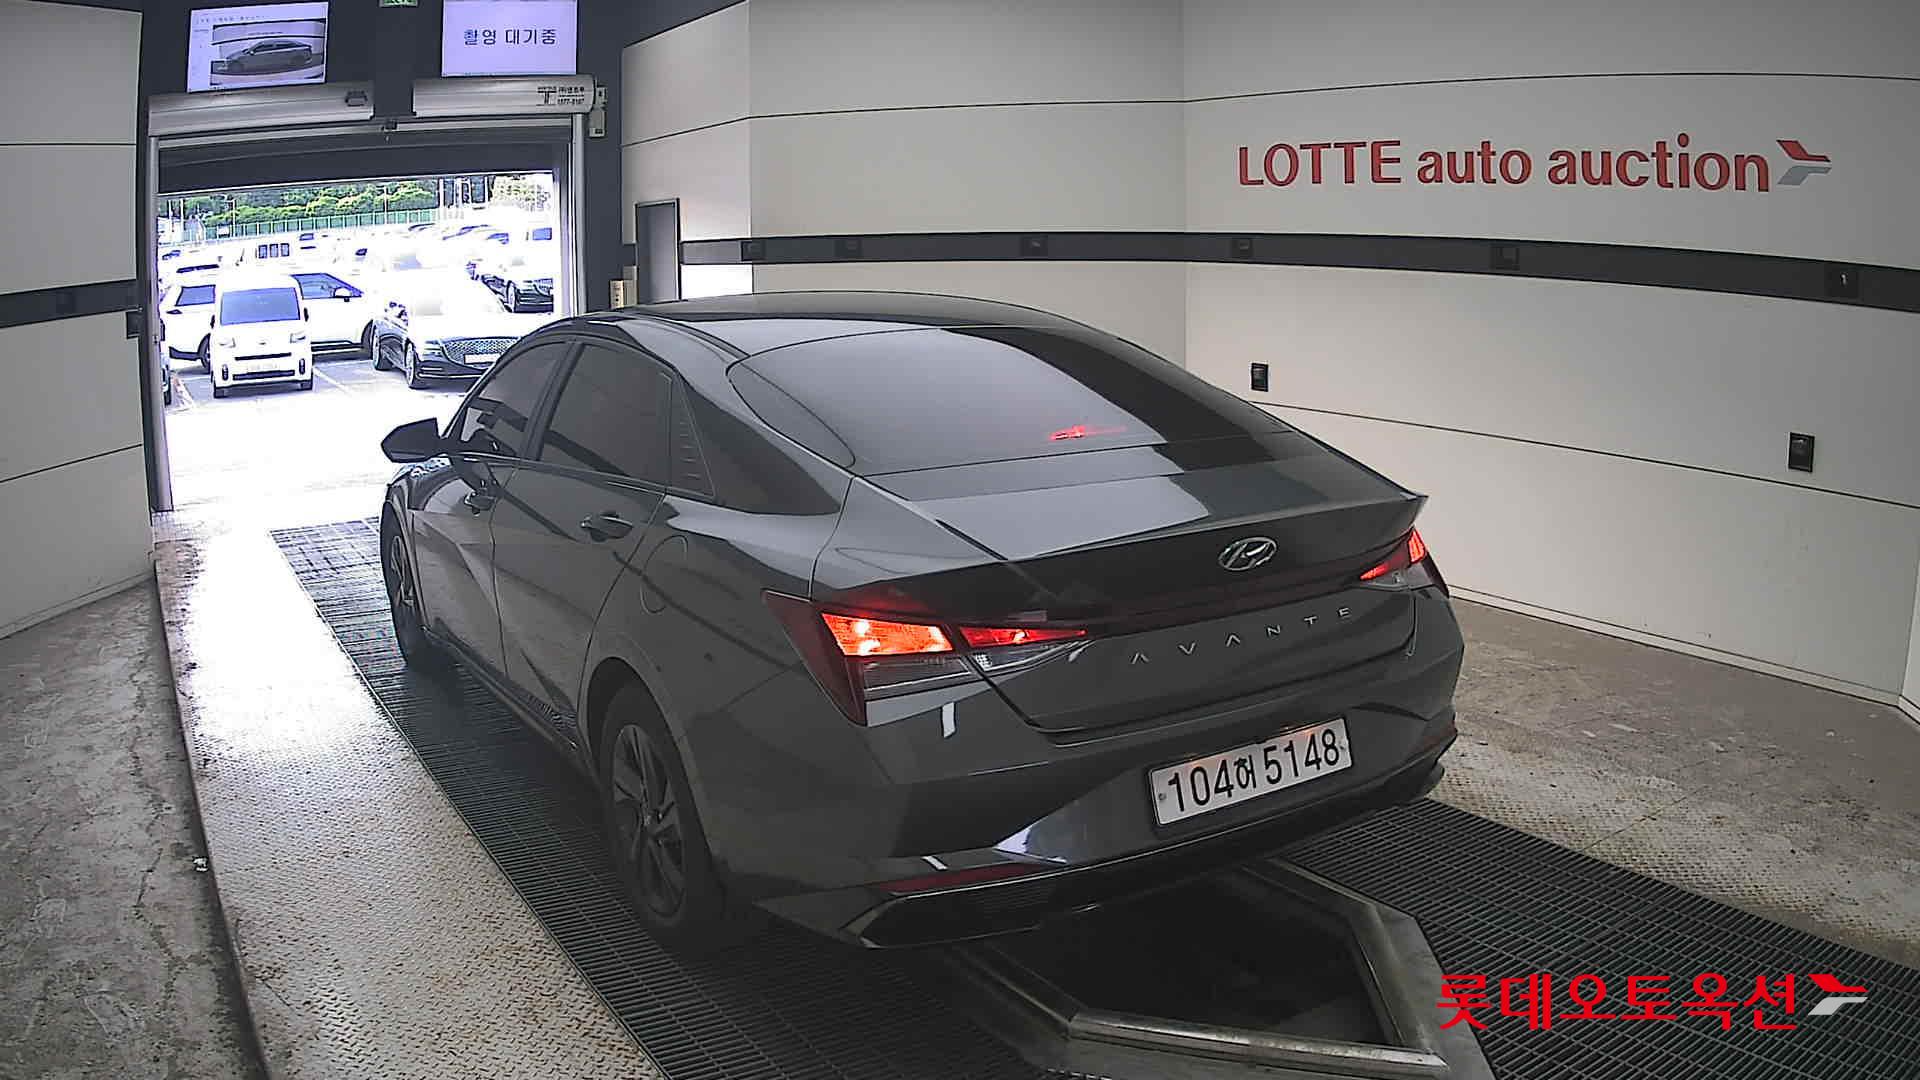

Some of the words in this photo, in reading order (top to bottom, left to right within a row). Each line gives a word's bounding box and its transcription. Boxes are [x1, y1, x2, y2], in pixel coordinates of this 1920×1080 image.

[505, 28, 556, 46] 대기중
[1239, 140, 1402, 186] LOTTE
[1417, 141, 1533, 184] auto
[1548, 133, 1770, 192] auction
[1130, 607, 1352, 664] AVANTE
[1167, 754, 1257, 812] 104허
[1263, 728, 1340, 785] 5148
